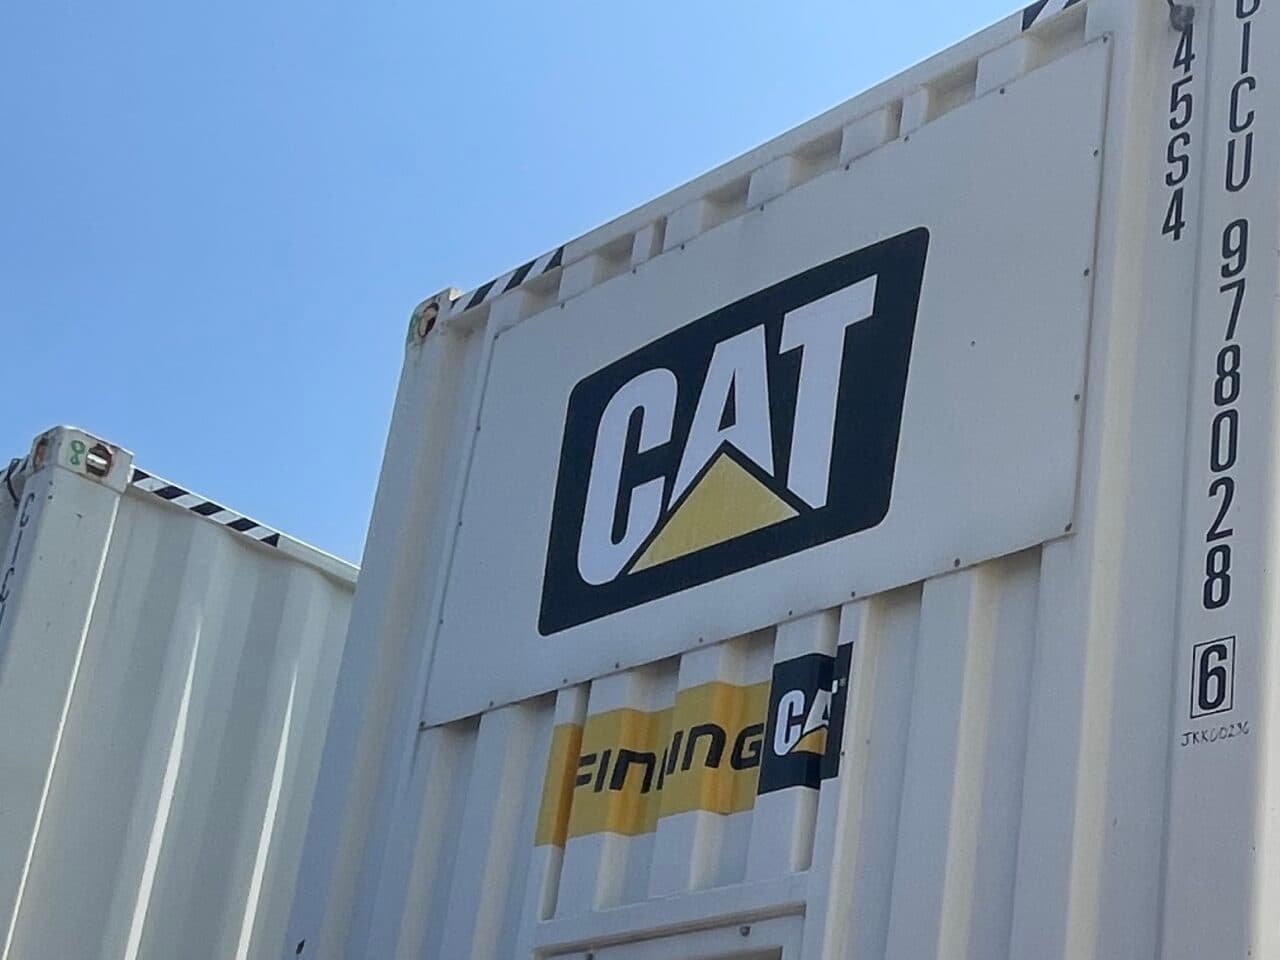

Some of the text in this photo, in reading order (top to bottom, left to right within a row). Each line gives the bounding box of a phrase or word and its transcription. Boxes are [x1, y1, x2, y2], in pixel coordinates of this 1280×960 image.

[576, 274, 878, 586] CAT
[1203, 219, 1249, 610] 978028
[575, 679, 839, 794] FINING CA
[1198, 643, 1228, 711] 6
